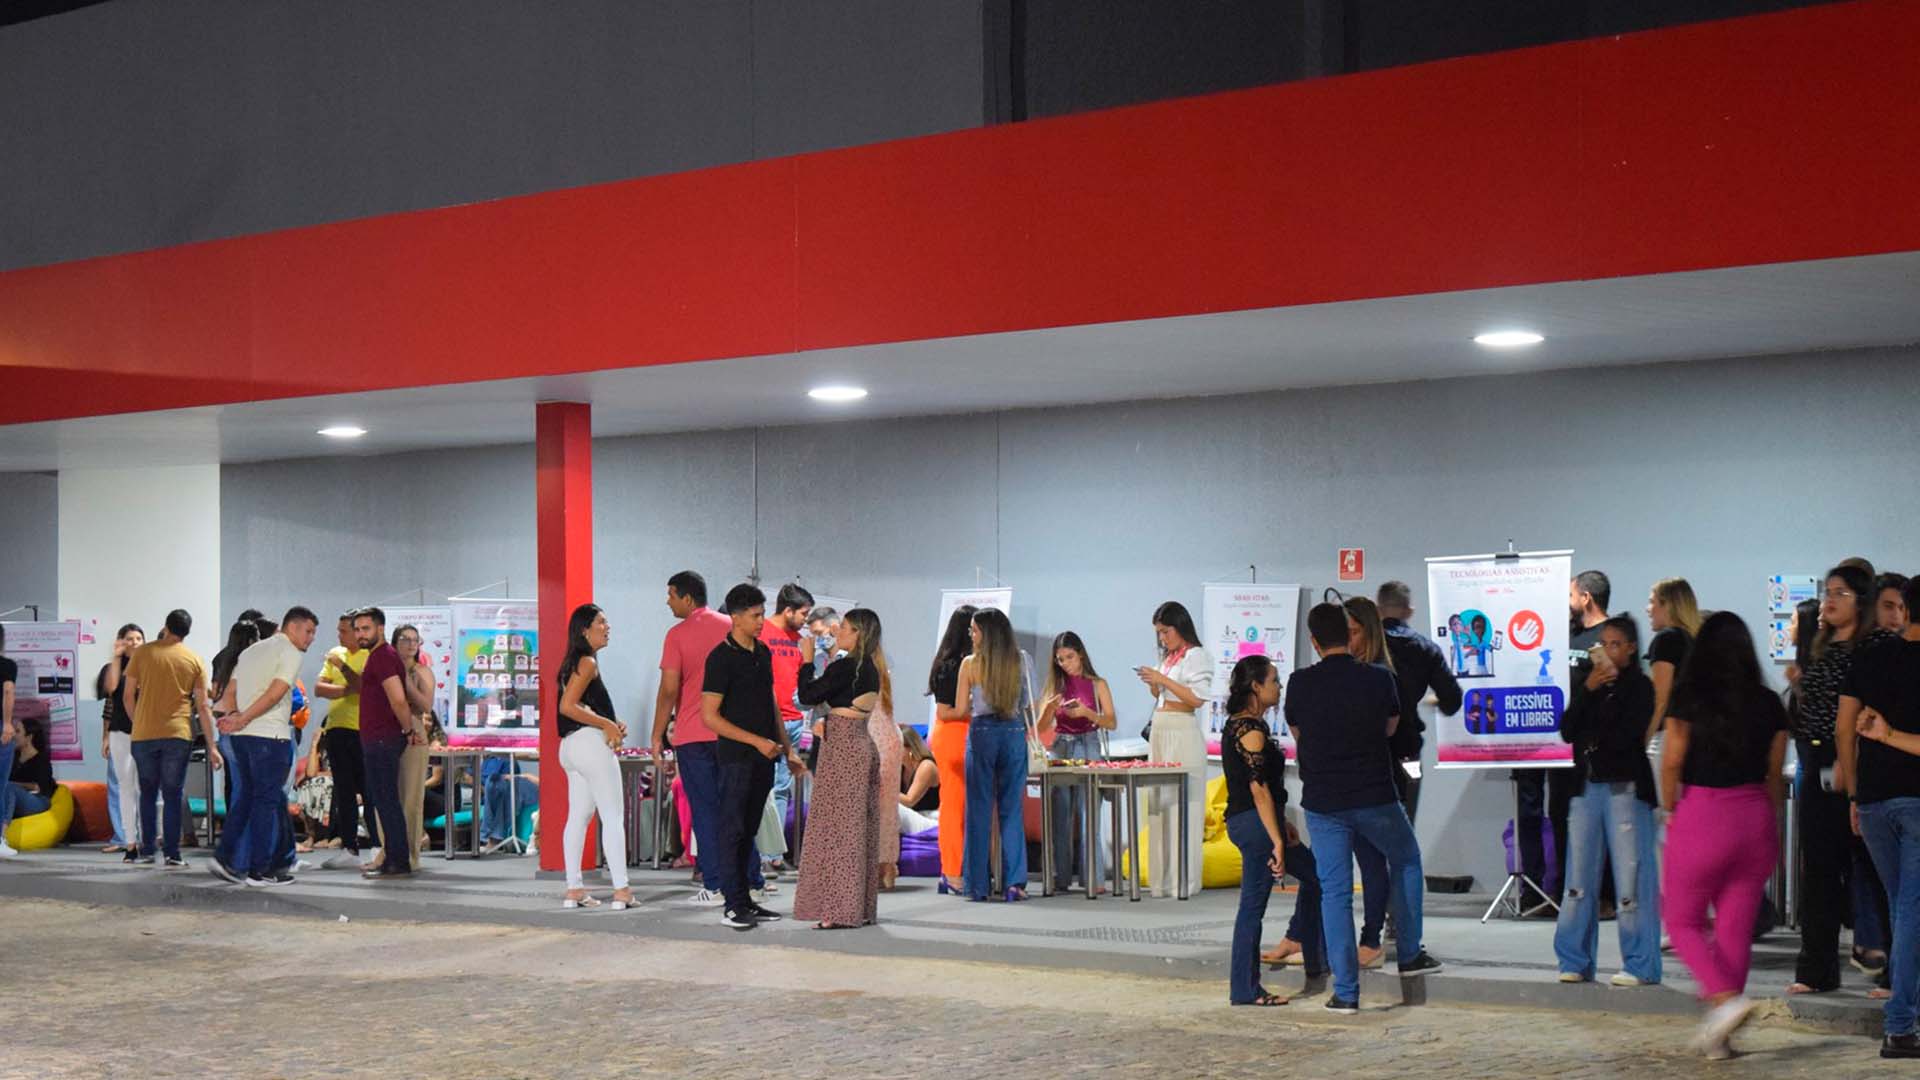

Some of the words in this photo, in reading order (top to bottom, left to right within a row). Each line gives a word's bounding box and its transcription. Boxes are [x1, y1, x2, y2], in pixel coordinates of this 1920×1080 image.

[1449, 568, 1502, 579] TECNOLOGIAS
[1503, 566, 1551, 577] ASSISTIVAS
[1505, 691, 1554, 710] ACESSÍVEL
[1505, 711, 1519, 727] EM
[1520, 711, 1554, 727] LIBRAS
